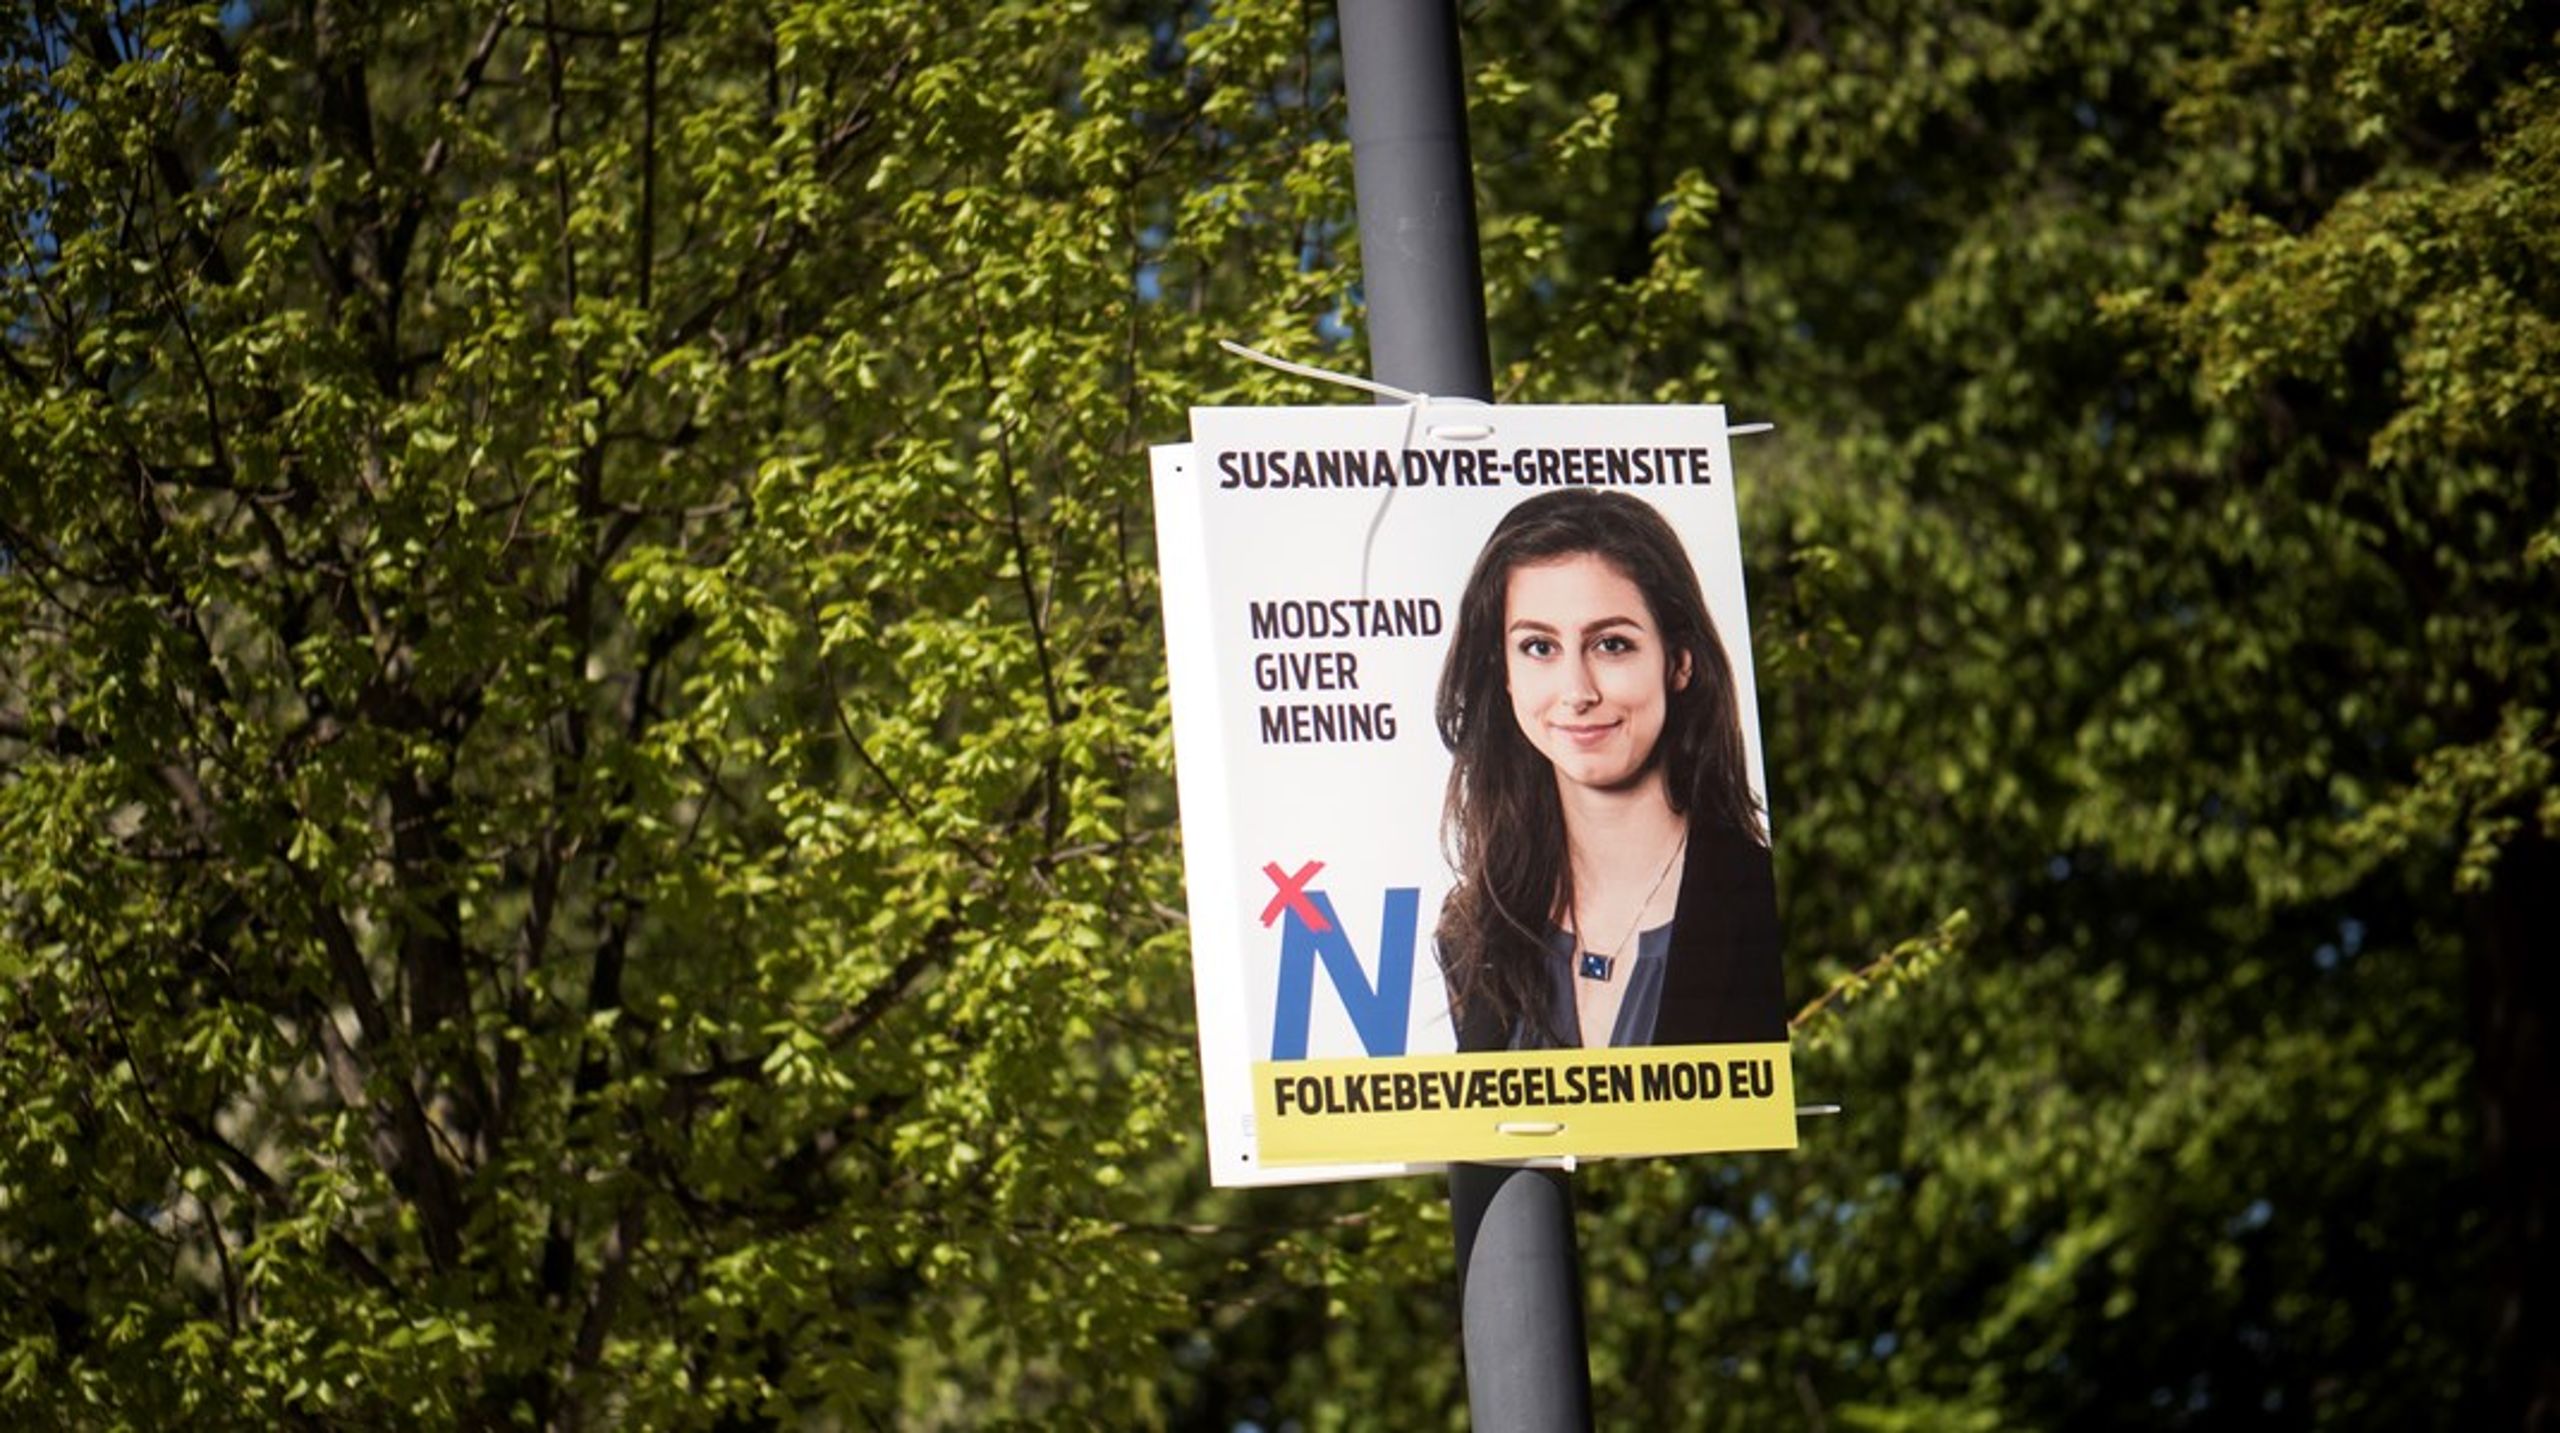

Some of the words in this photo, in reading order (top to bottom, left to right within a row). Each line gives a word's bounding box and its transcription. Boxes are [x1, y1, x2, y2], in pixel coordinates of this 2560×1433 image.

[1218, 448, 1397, 489] SUSANNA
[1404, 447, 1711, 487] DYRE-GREENSITE
[1250, 598, 1442, 640] MODSTAND
[1255, 652, 1358, 692] GIVER
[1260, 703, 1396, 744] MENING
[1271, 887, 1420, 1060] N
[1274, 1064, 1635, 1116] FOLKEBEVÆGELSEN
[1641, 1061, 1722, 1102] MOD
[1729, 1059, 1774, 1098] EU
